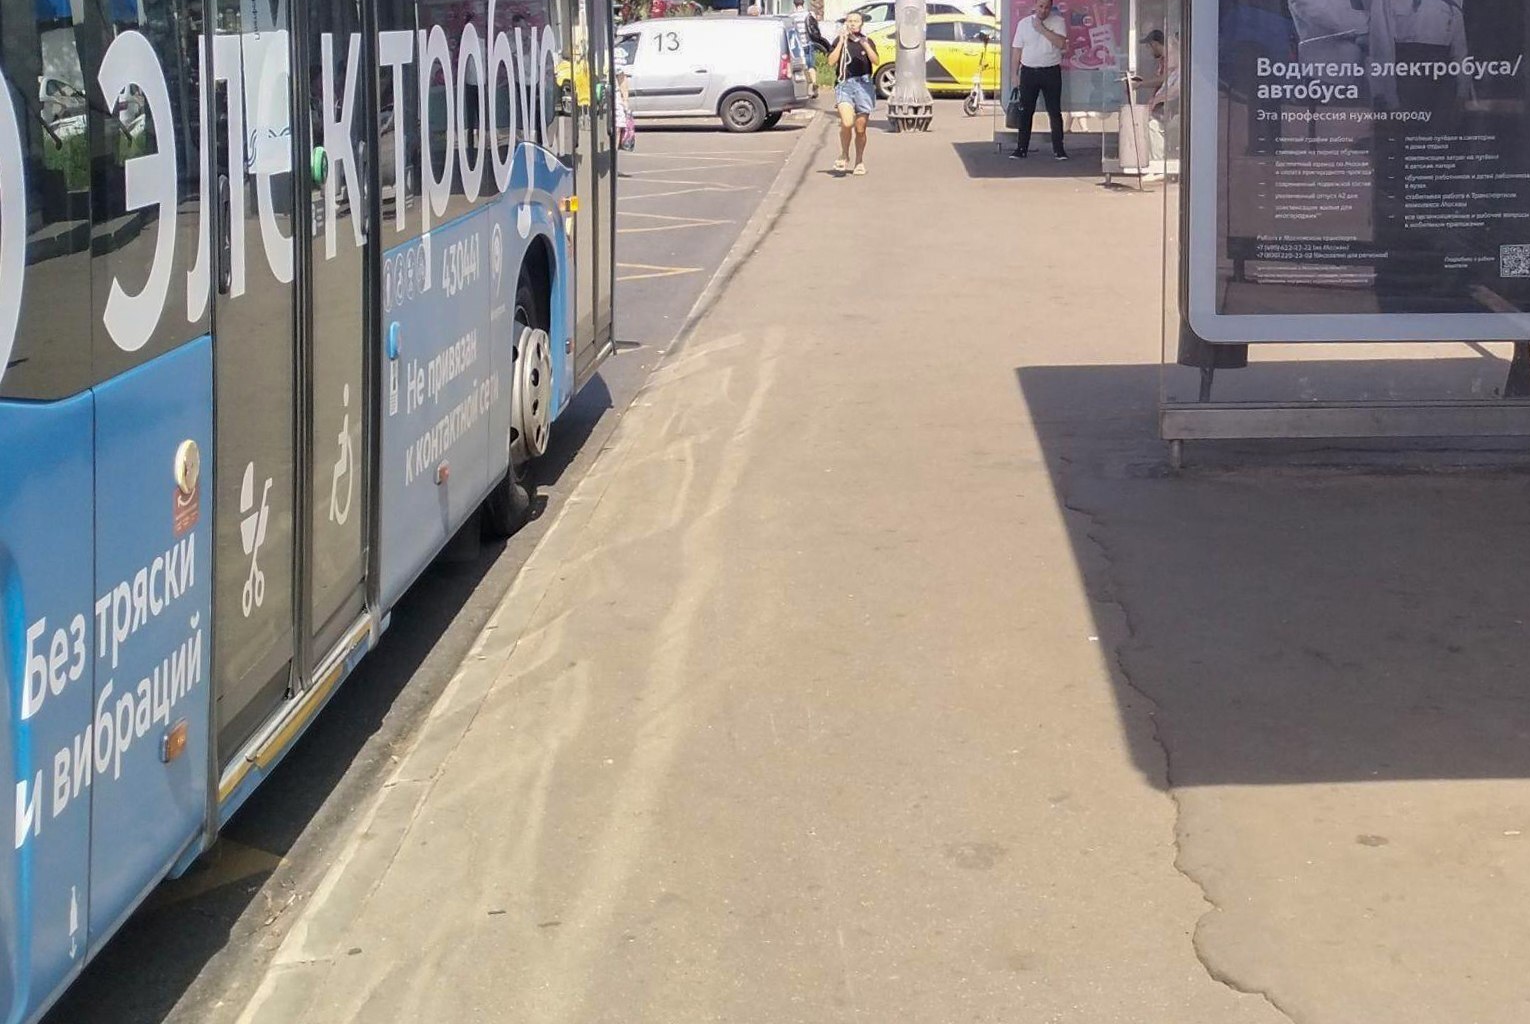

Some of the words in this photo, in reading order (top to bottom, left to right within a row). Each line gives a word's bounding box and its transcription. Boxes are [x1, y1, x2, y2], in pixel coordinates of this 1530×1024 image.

[653, 31, 680, 53] 13
[1256, 57, 1365, 80] Водитель
[1370, 54, 1523, 81] электробуса/
[1256, 79, 1359, 104] автобуса
[1256, 109, 1279, 121] Эта
[1280, 109, 1347, 124] профессия
[1349, 111, 1388, 123] нужна
[1390, 110, 1433, 122] городу
[441, 232, 481, 299] 430441
[406, 358, 425, 415] Не
[427, 328, 478, 405] привязан
[405, 445, 415, 487] к
[415, 378, 479, 477] контактной
[20, 613, 87, 721] Без
[95, 532, 196, 669] тряски
[14, 769, 43, 849] и
[52, 611, 203, 819] вибраций
